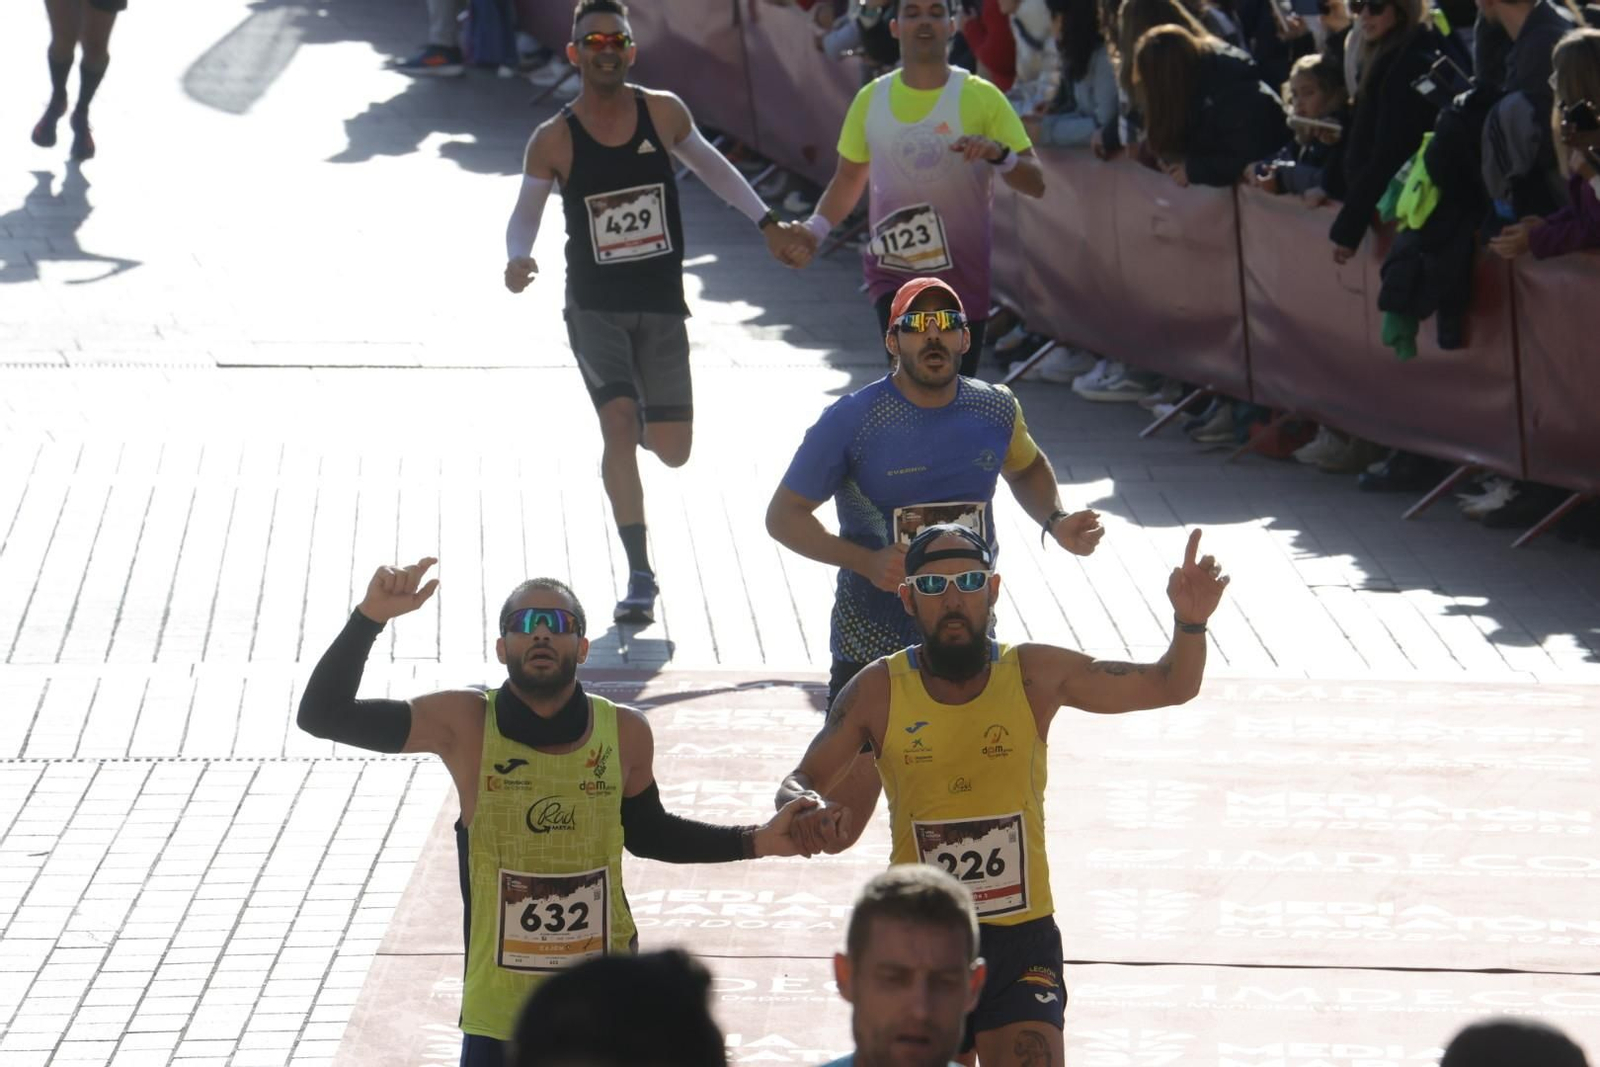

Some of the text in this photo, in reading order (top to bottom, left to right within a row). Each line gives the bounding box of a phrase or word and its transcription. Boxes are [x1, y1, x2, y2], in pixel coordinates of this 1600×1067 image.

[605, 208, 651, 235] 429
[880, 224, 931, 254] 1123
[1225, 790, 1447, 806] MEDIA
[937, 848, 1005, 881] 226
[1204, 849, 1600, 871] IMDECO
[520, 901, 589, 933] 632
[630, 902, 854, 918] MARAT
[1218, 900, 1453, 918] MEDIA
[632, 918, 837, 929] ORDOBA
[1198, 984, 1600, 1009] IMDECO
